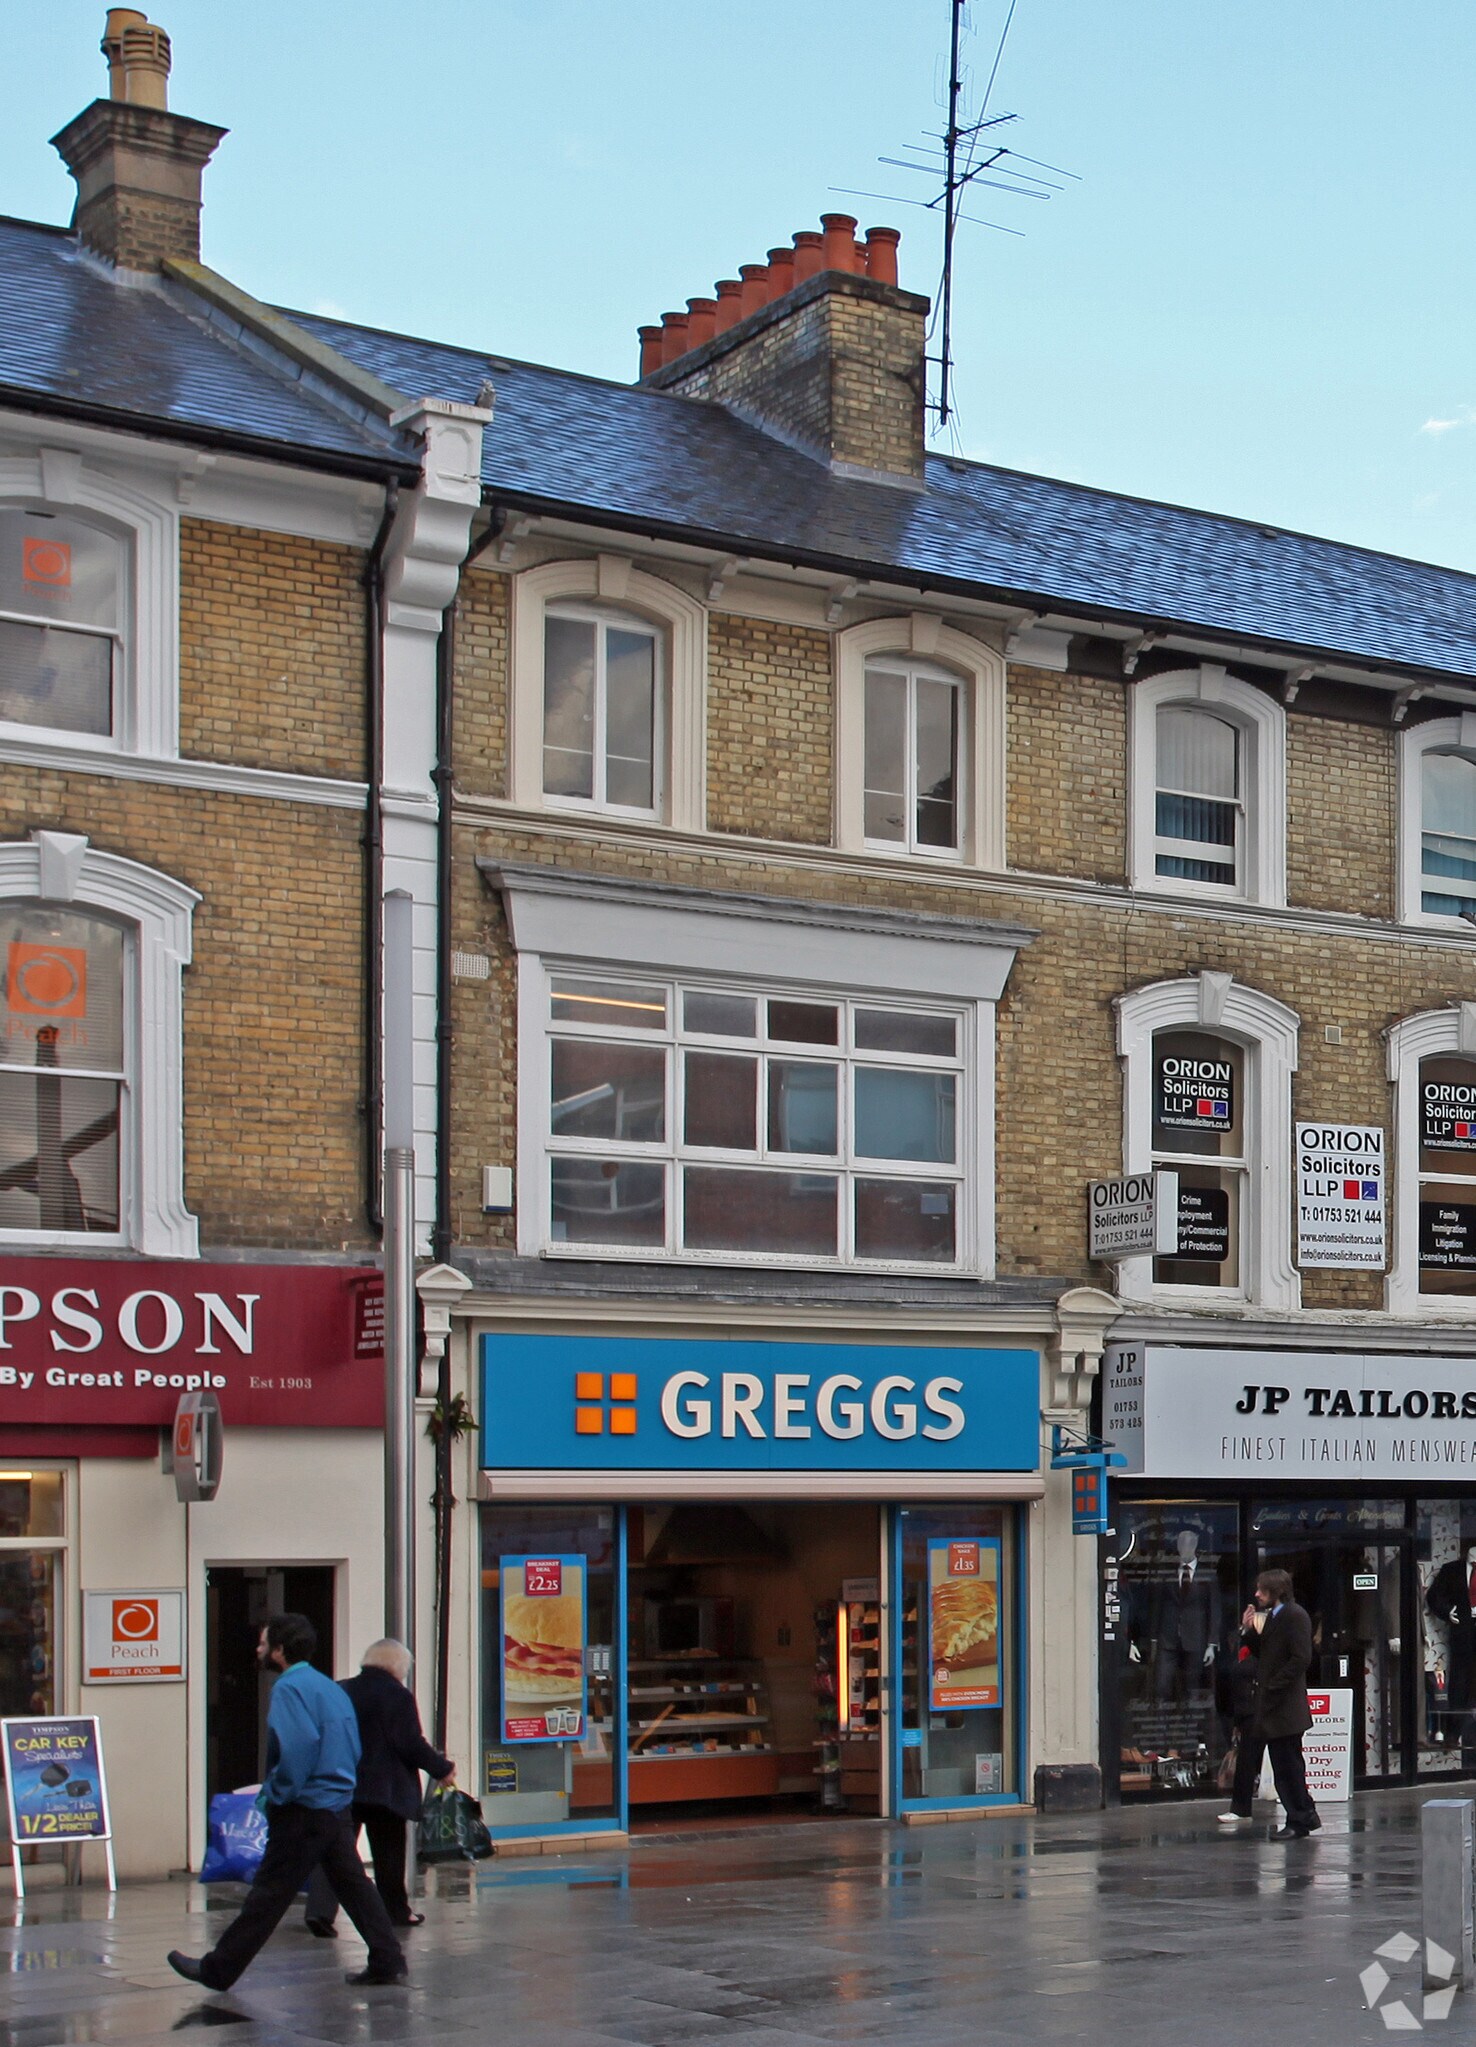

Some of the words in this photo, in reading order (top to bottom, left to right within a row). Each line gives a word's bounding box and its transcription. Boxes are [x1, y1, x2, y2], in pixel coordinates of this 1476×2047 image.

[5, 1018, 88, 1045] Peach
[1162, 1057, 1230, 1080] ORION
[1163, 1078, 1229, 1099] Solicitors
[1164, 1096, 1193, 1113] LLP
[1426, 1120, 1452, 1135] LLP
[1300, 1128, 1381, 1153] ORION
[1301, 1155, 1381, 1177] Solicitors
[1093, 1177, 1154, 1208] ORION
[1303, 1178, 1339, 1198] LLP
[1181, 1195, 1202, 1206] Crime
[1094, 1211, 1139, 1229] Solicitors
[1140, 1210, 1154, 1222] LLP
[1178, 1210, 1213, 1222] ployment
[1301, 1206, 1310, 1221] T:
[1312, 1207, 1342, 1222] 01753
[1344, 1208, 1361, 1223] 521
[1364, 1210, 1382, 1224] 444
[1439, 1209, 1459, 1222] Family
[1178, 1224, 1228, 1236] ny/Commercial
[1431, 1223, 1467, 1235] Immigration
[1094, 1231, 1123, 1245] T:01753
[1124, 1229, 1138, 1241] 521
[1140, 1228, 1154, 1239] 444
[1300, 1232, 1384, 1246] www.orionsolicitors.co.uk
[1180, 1240, 1187, 1250] of
[1188, 1241, 1223, 1252] Protection
[1435, 1238, 1464, 1250] Litigation
[1300, 1248, 1383, 1262] info@orionsolicitors.co.uk
[1448, 1253, 1453, 1262] &
[1116, 1351, 1137, 1374] JP
[0, 1366, 35, 1389] By
[46, 1367, 123, 1387] Great
[134, 1369, 227, 1391] People
[249, 1376, 274, 1389] Est
[279, 1377, 313, 1389] 1903
[1109, 1376, 1142, 1389] TAILORS
[660, 1370, 967, 1441] GREGGS
[1114, 1400, 1138, 1412] 01753
[1236, 1385, 1290, 1415] JP
[1304, 1388, 1476, 1419] TAILORS
[1109, 1418, 1124, 1430] 573
[1127, 1416, 1142, 1428] 425
[1221, 1437, 1286, 1460] FINEST
[1301, 1438, 1376, 1461] ITALIAN
[1356, 1578, 1375, 1586] OPEN
[111, 1644, 159, 1659] Peach
[109, 1667, 132, 1676] FIRST
[134, 1665, 161, 1675] FLOOR
[1309, 1699, 1325, 1711] JP
[1314, 1716, 1346, 1724] ILORS
[15, 1737, 52, 1752] CAR
[57, 1736, 89, 1749] KEY
[1301, 1744, 1347, 1753] eration
[24, 1749, 83, 1764] Specialists
[1309, 1756, 1333, 1767] Dry
[1303, 1768, 1342, 1779] aning
[1304, 1781, 1337, 1790] rvice
[21, 1812, 59, 1835] 1/2
[58, 1812, 99, 1824] DEALER
